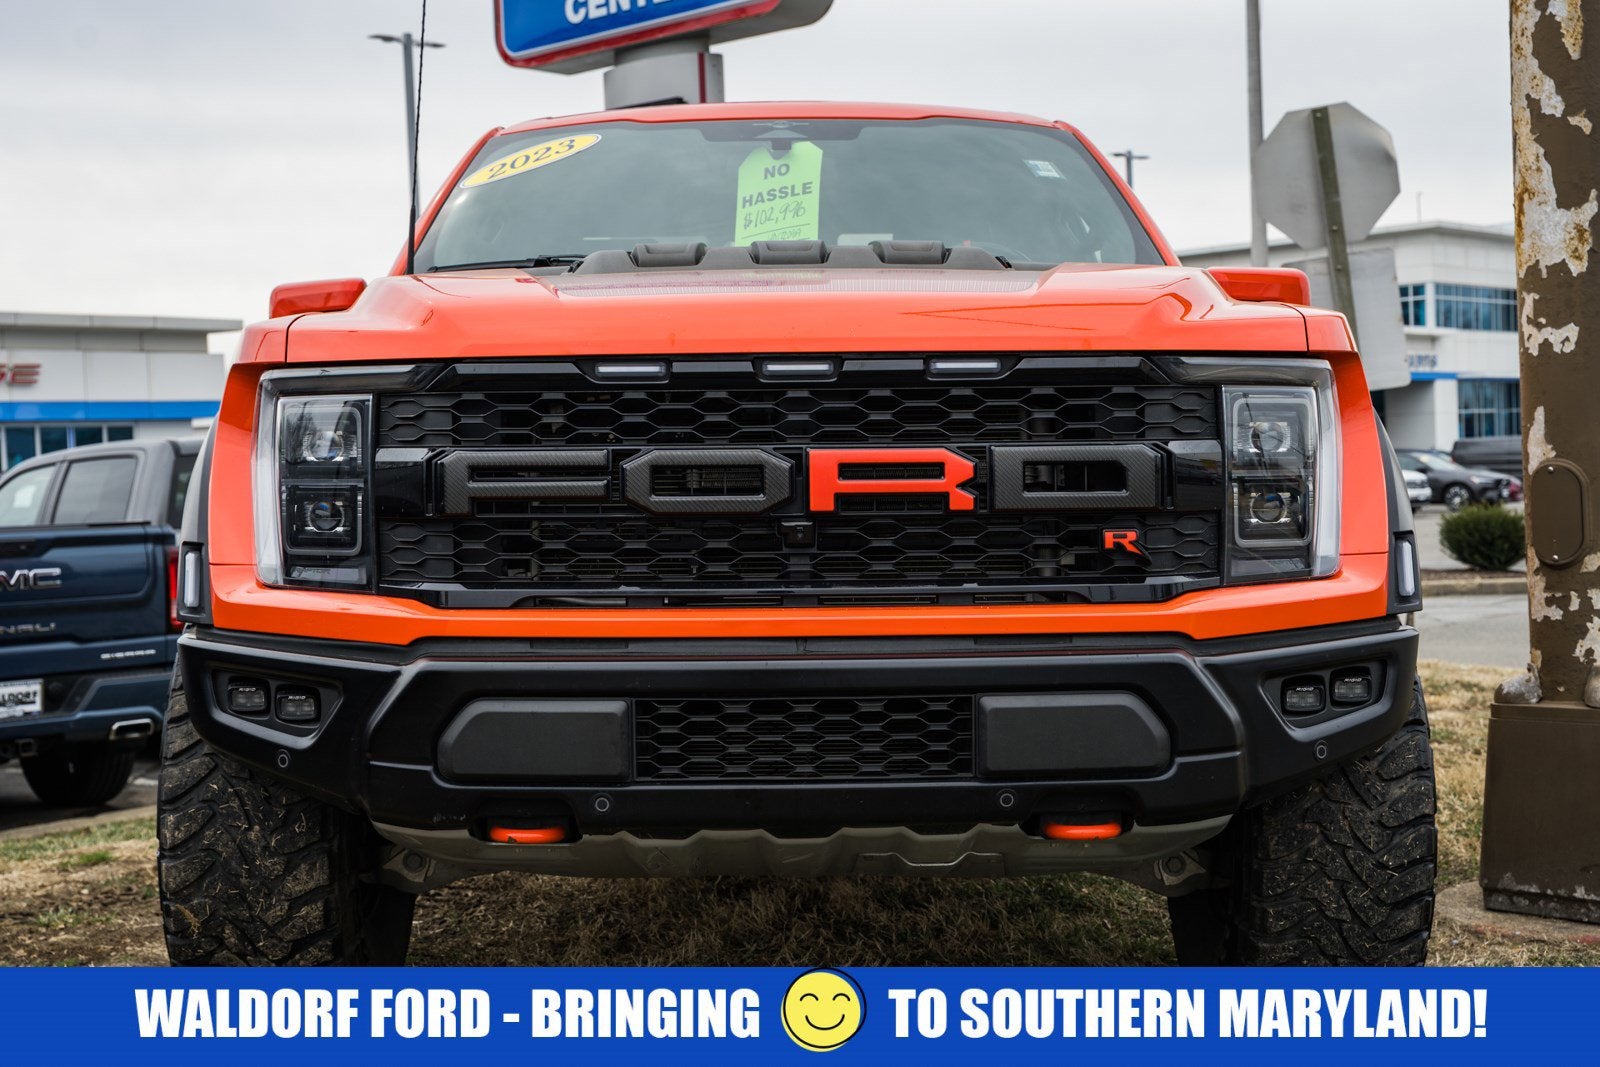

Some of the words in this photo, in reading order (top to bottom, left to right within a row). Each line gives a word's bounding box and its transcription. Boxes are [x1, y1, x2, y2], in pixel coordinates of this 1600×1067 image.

[487, 138, 576, 180] 2023
[763, 162, 790, 180] NO
[742, 181, 813, 209] HASSLE
[0, 362, 42, 385] E
[443, 444, 1157, 515] FORD
[1103, 529, 1144, 556] R
